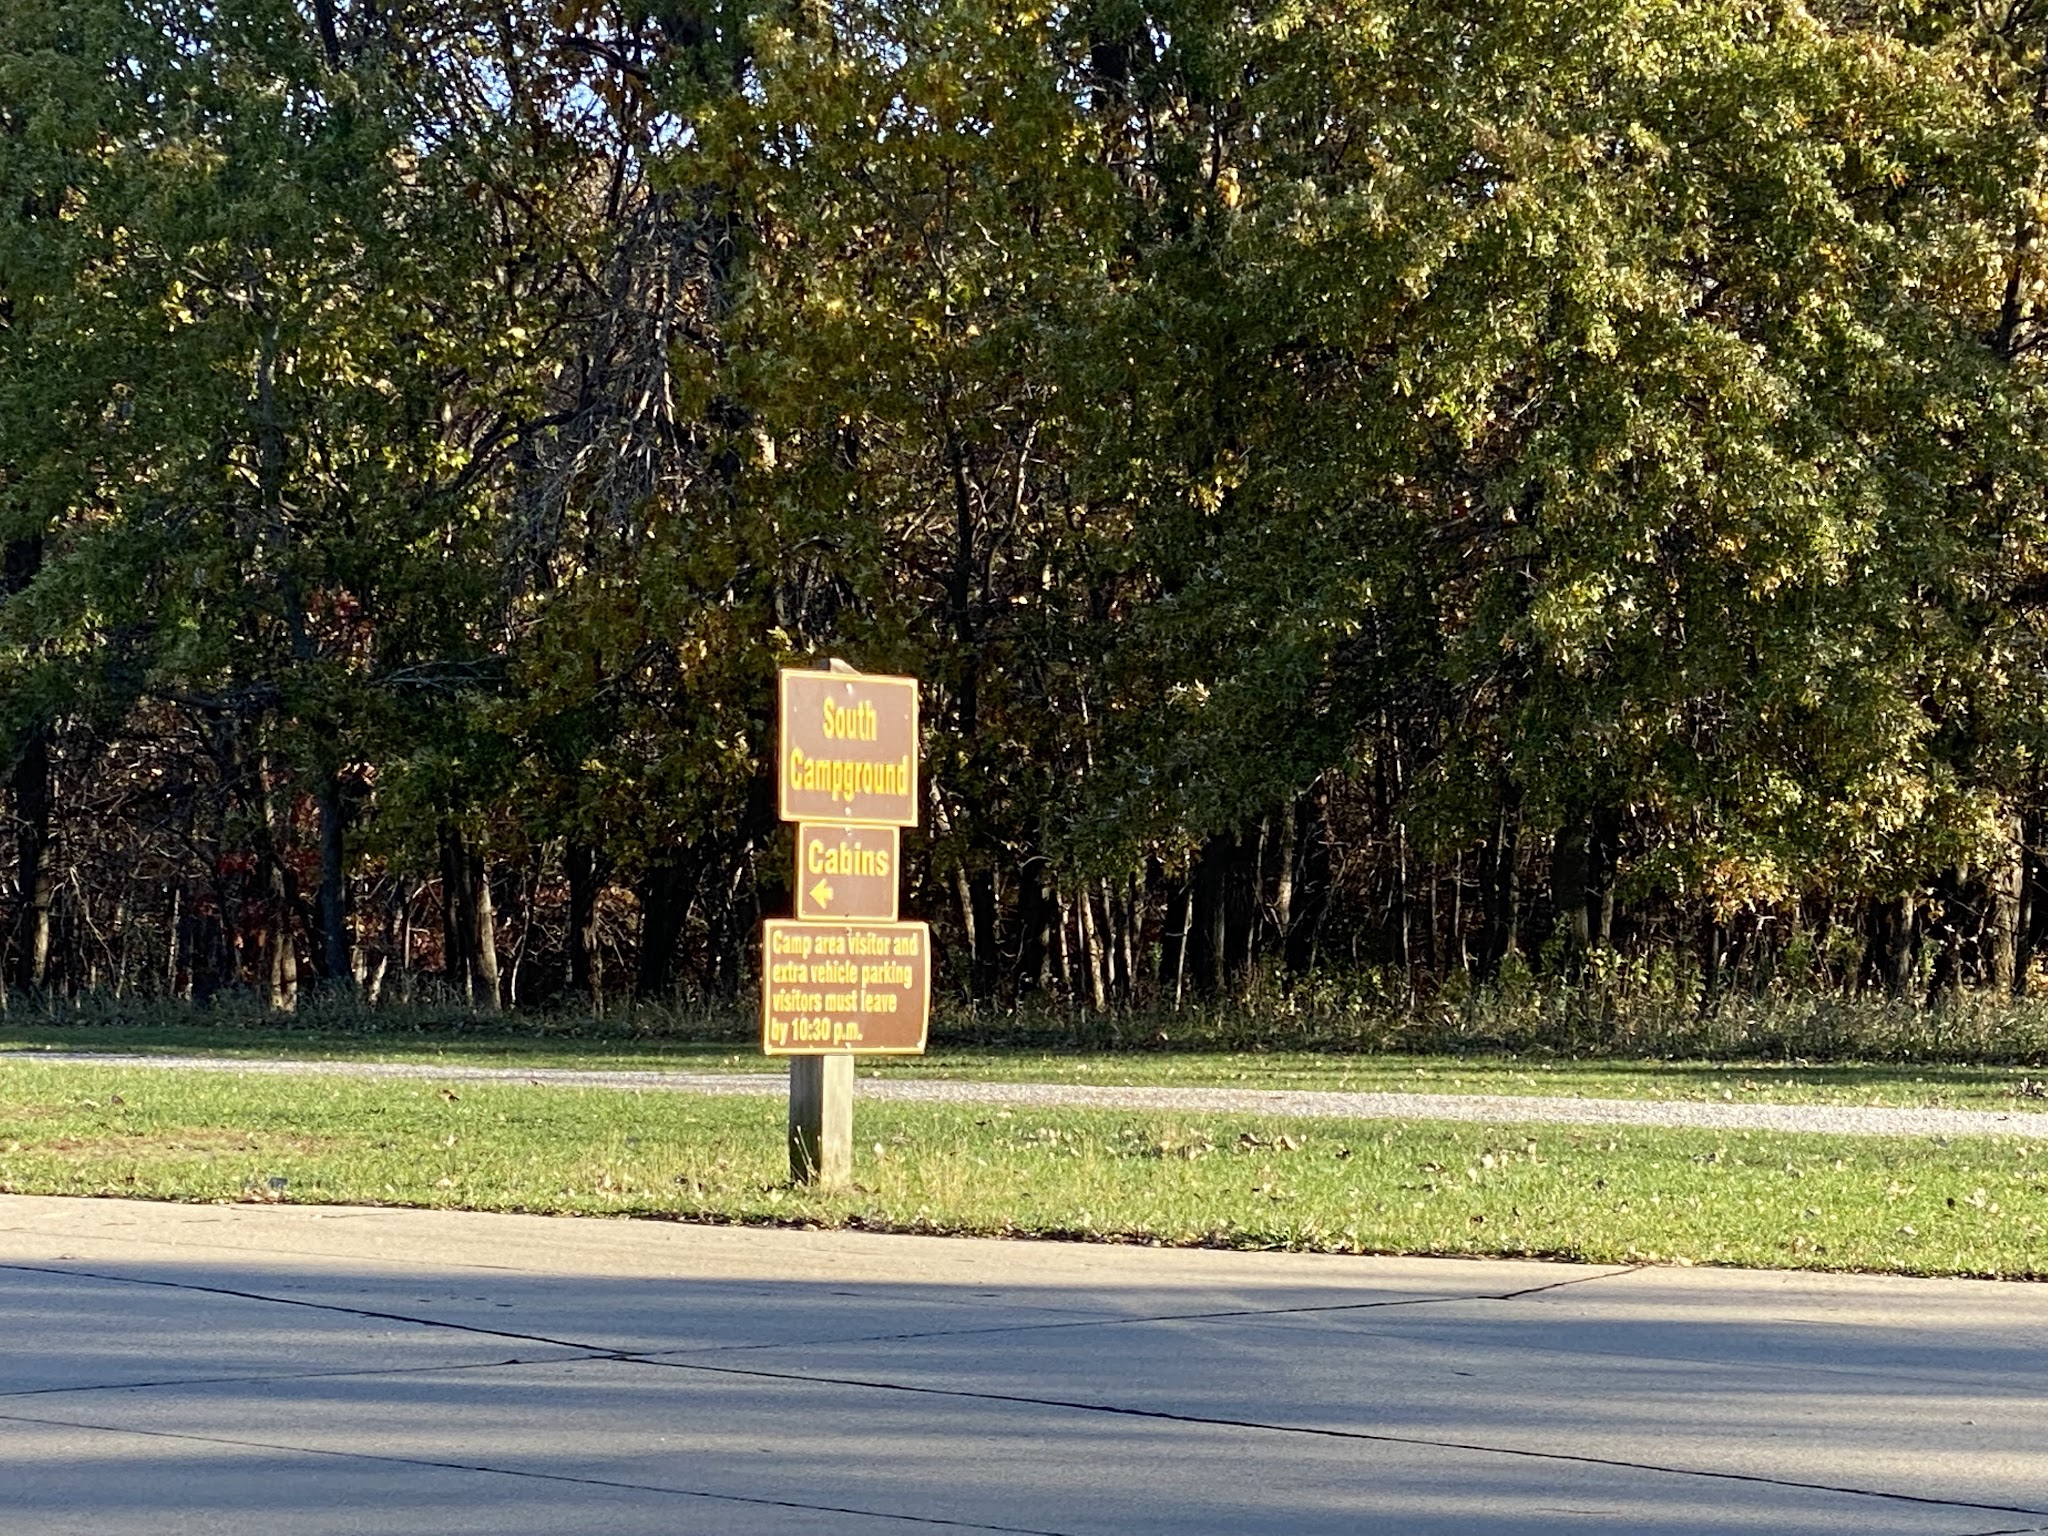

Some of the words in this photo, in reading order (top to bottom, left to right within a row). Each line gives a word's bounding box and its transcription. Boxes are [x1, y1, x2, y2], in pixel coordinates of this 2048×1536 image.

[823, 696, 877, 741] South
[790, 747, 909, 802] Campground
[808, 839, 889, 877] Cabins
[772, 929, 812, 960] Camp
[814, 935, 845, 955] area
[848, 931, 891, 956] visitor
[893, 932, 919, 956] and
[772, 960, 808, 983] extra
[810, 959, 858, 984] vehicle
[861, 960, 912, 989] parking
[772, 988, 822, 1012] visitors
[825, 989, 858, 1012] must
[860, 989, 897, 1013] leave
[771, 1017, 789, 1046] by
[791, 1017, 831, 1041] 10:30
[833, 1021, 863, 1046] p.m.
